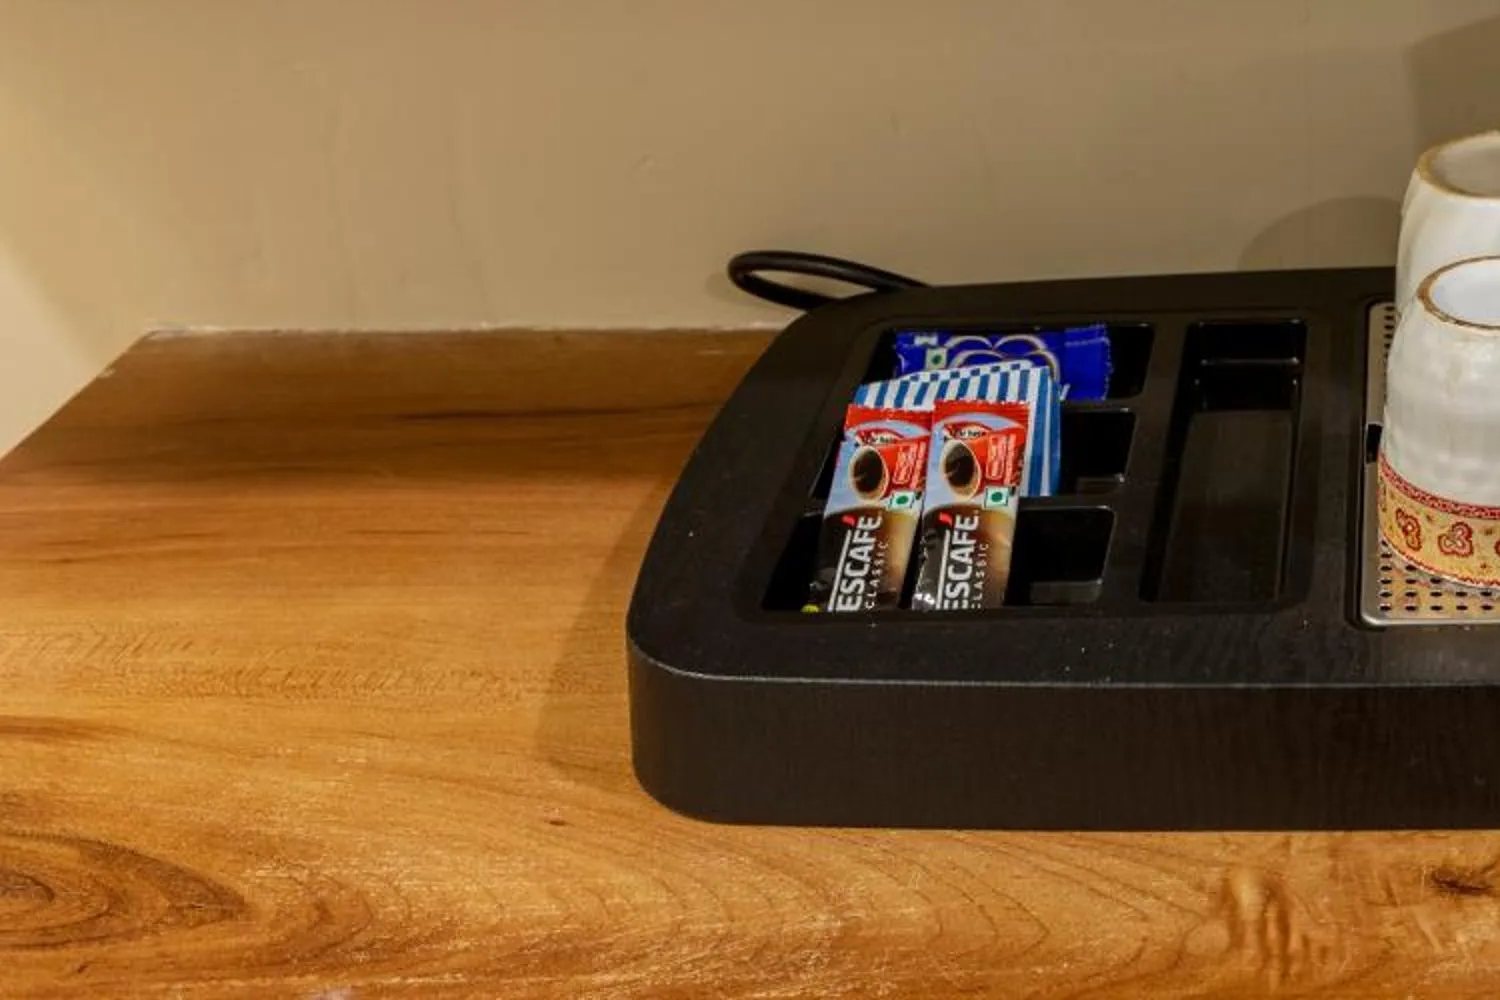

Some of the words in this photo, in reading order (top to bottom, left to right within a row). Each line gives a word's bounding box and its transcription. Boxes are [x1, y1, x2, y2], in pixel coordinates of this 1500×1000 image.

[828, 514, 882, 612] ESCAFÉ
[865, 541, 889, 611] CLASSIC
[935, 513, 981, 611] ESCAFÉ
